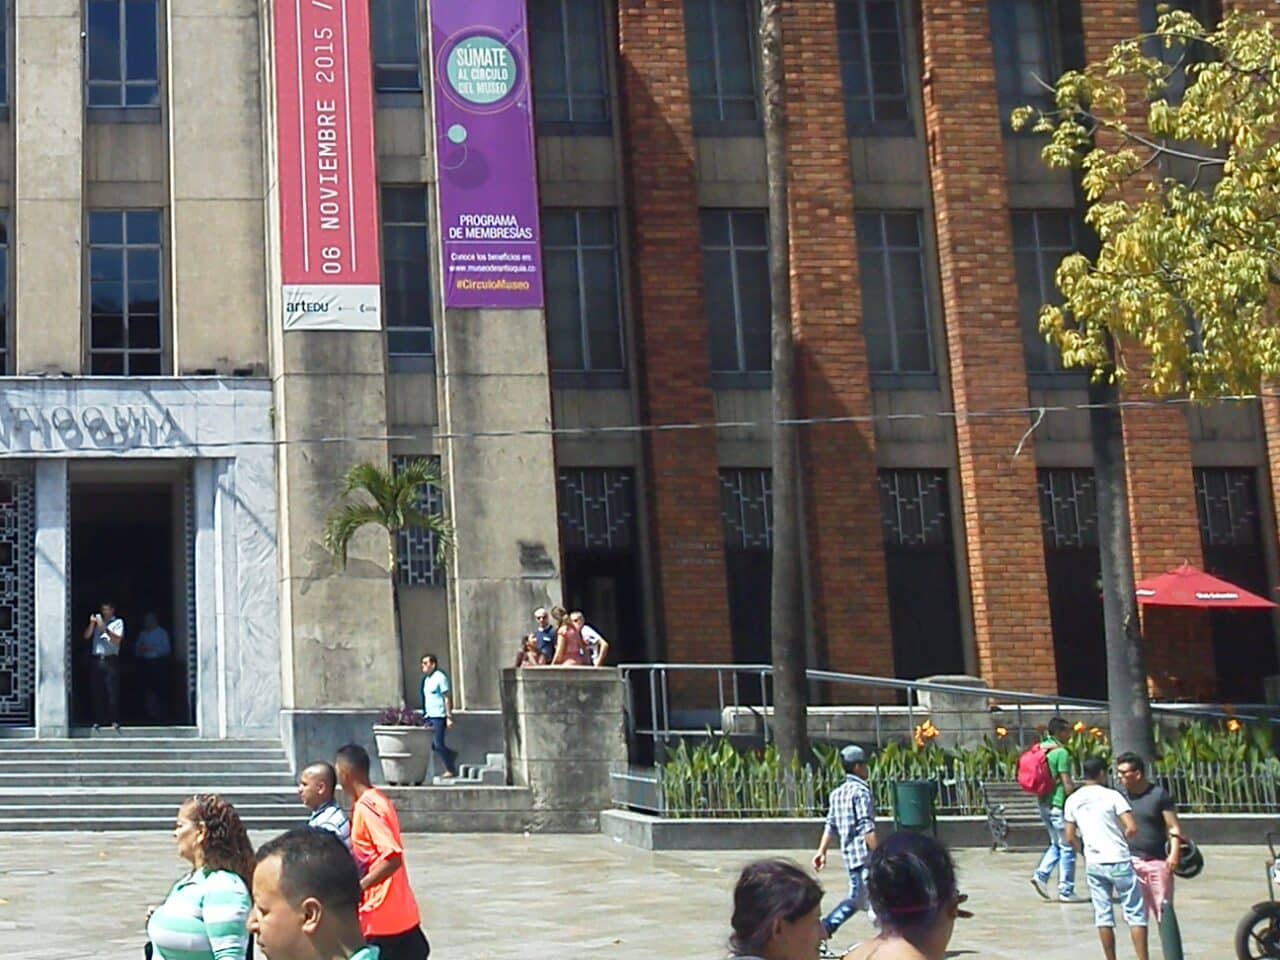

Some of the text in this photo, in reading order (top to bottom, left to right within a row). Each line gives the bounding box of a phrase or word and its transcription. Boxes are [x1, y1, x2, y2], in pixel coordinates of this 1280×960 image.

[313, 26, 335, 83] 2015
[457, 43, 507, 67] SÚMATE
[458, 68, 469, 80] AL
[476, 81, 507, 95] MUSEO
[316, 99, 340, 229] NOVIEMBRE
[460, 214, 517, 226] PROGRAMA
[449, 227, 463, 239] DE
[321, 246, 342, 274] 06
[286, 300, 329, 312] artEDU
